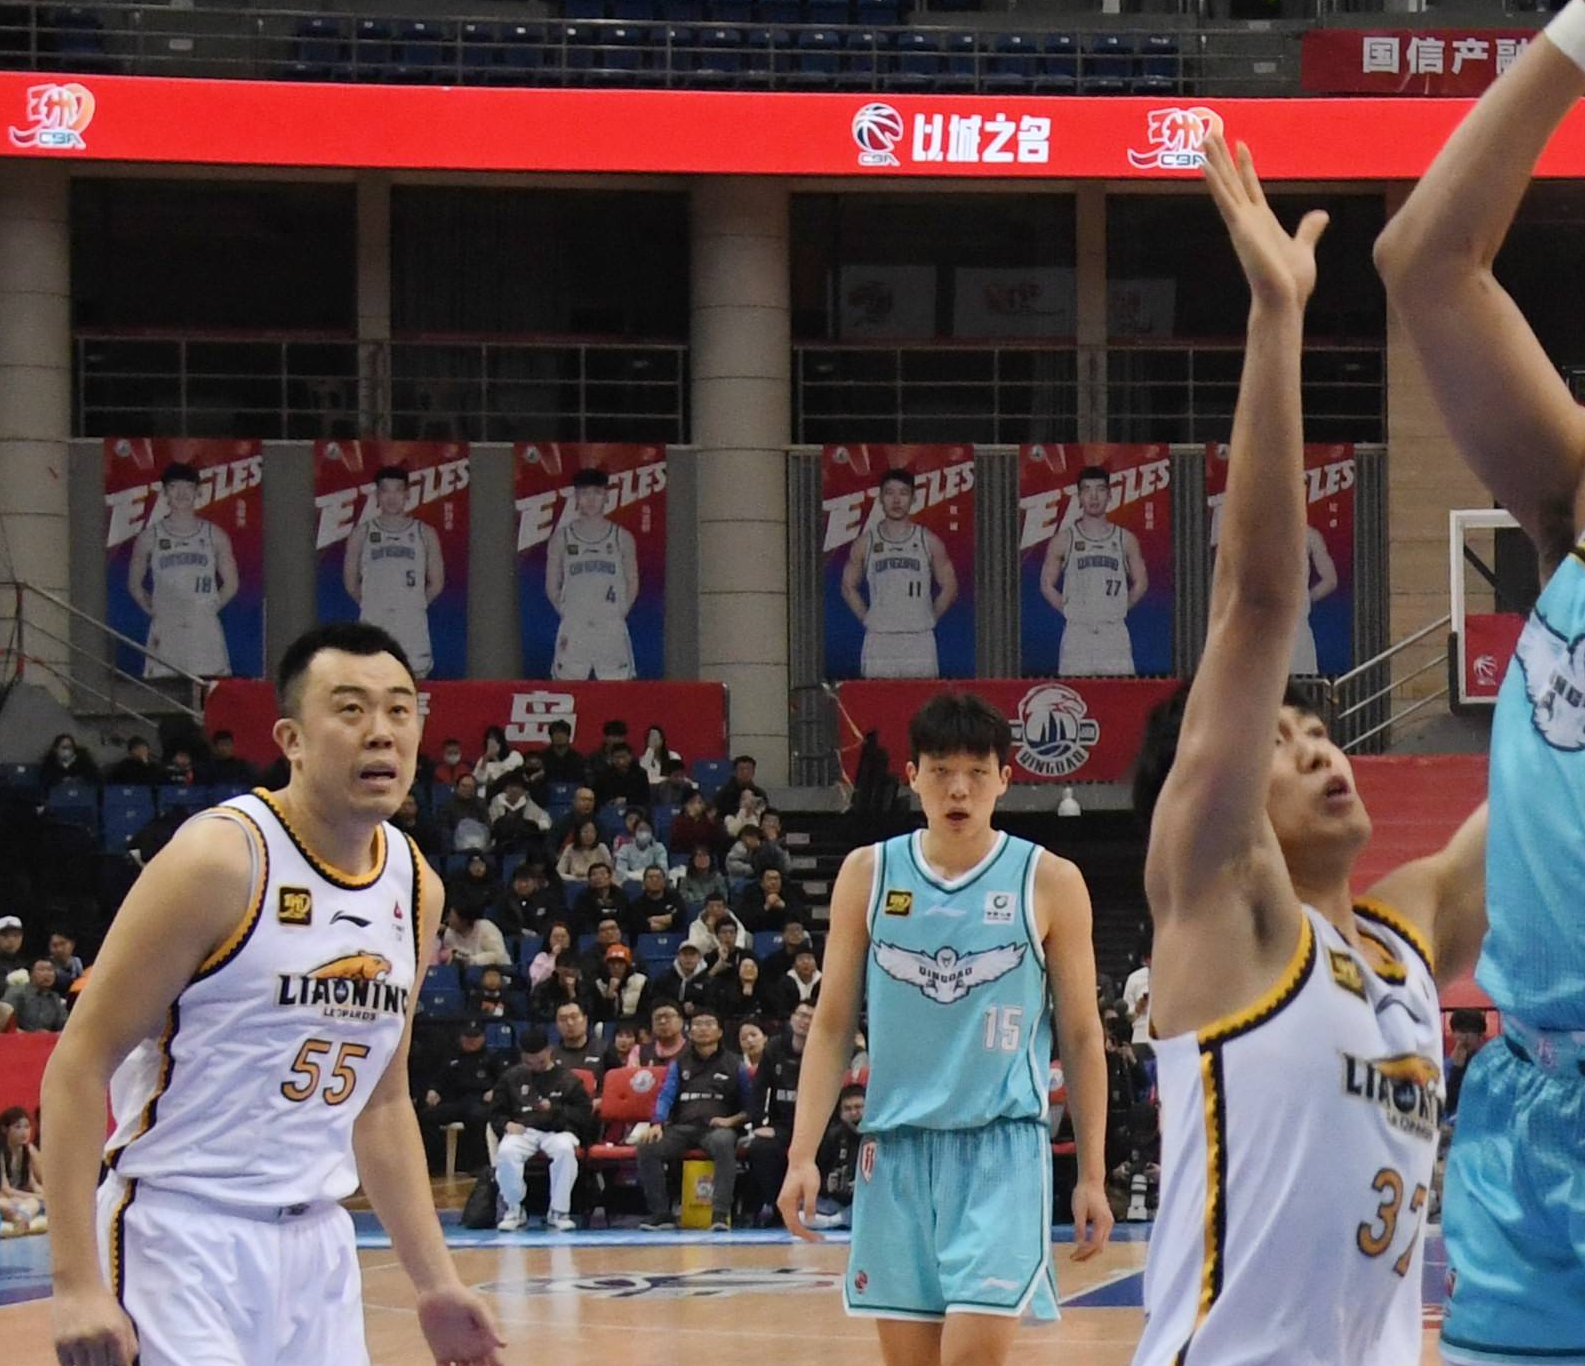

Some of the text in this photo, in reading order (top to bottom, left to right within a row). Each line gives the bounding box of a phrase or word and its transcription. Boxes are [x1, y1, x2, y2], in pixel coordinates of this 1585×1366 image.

[912, 112, 1051, 164] 以城之名
[405, 569, 417, 588] 5
[604, 585, 617, 604] 4
[919, 966, 973, 983] QINGDAO
[982, 1003, 1025, 1052] 15
[280, 1038, 371, 1106] 55
